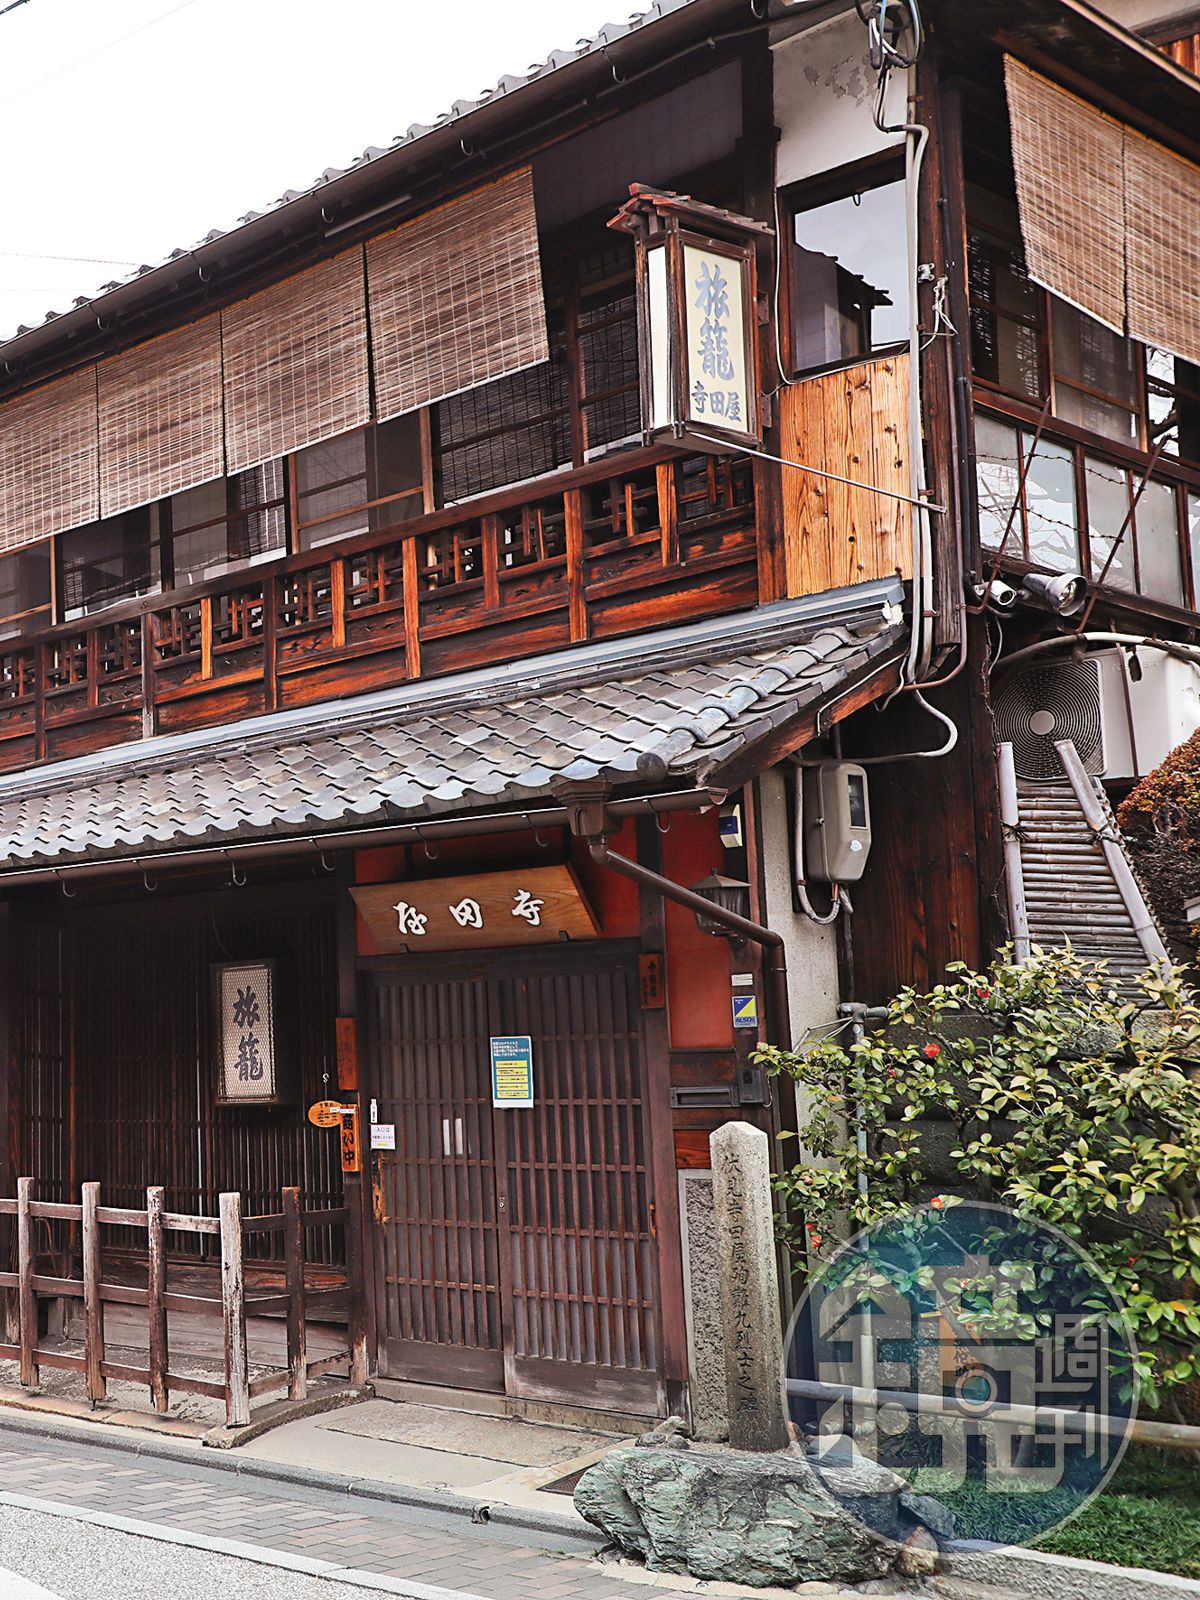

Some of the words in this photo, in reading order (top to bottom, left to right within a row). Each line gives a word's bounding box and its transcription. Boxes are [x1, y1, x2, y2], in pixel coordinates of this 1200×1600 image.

[695, 261, 735, 381] 旅籠
[691, 380, 742, 422] 寺田屋
[233, 985, 264, 1081] 旅籠
